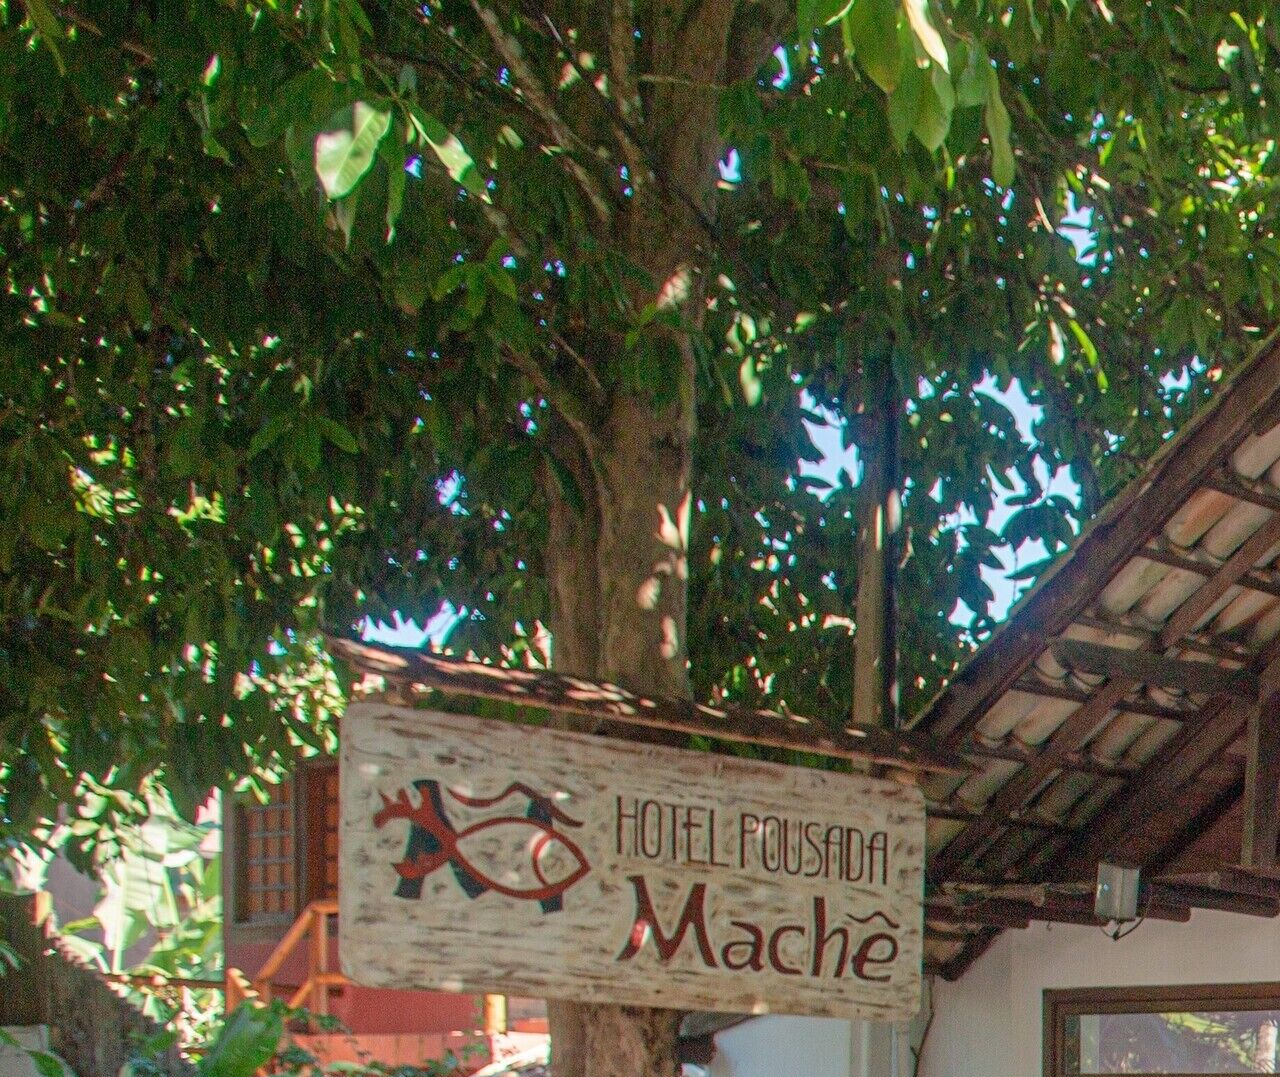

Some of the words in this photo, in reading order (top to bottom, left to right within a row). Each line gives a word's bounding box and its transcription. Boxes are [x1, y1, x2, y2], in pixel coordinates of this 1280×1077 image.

[615, 795, 728, 868] HOTEL
[739, 812, 889, 886] POUSADA
[616, 874, 901, 984] Machê
